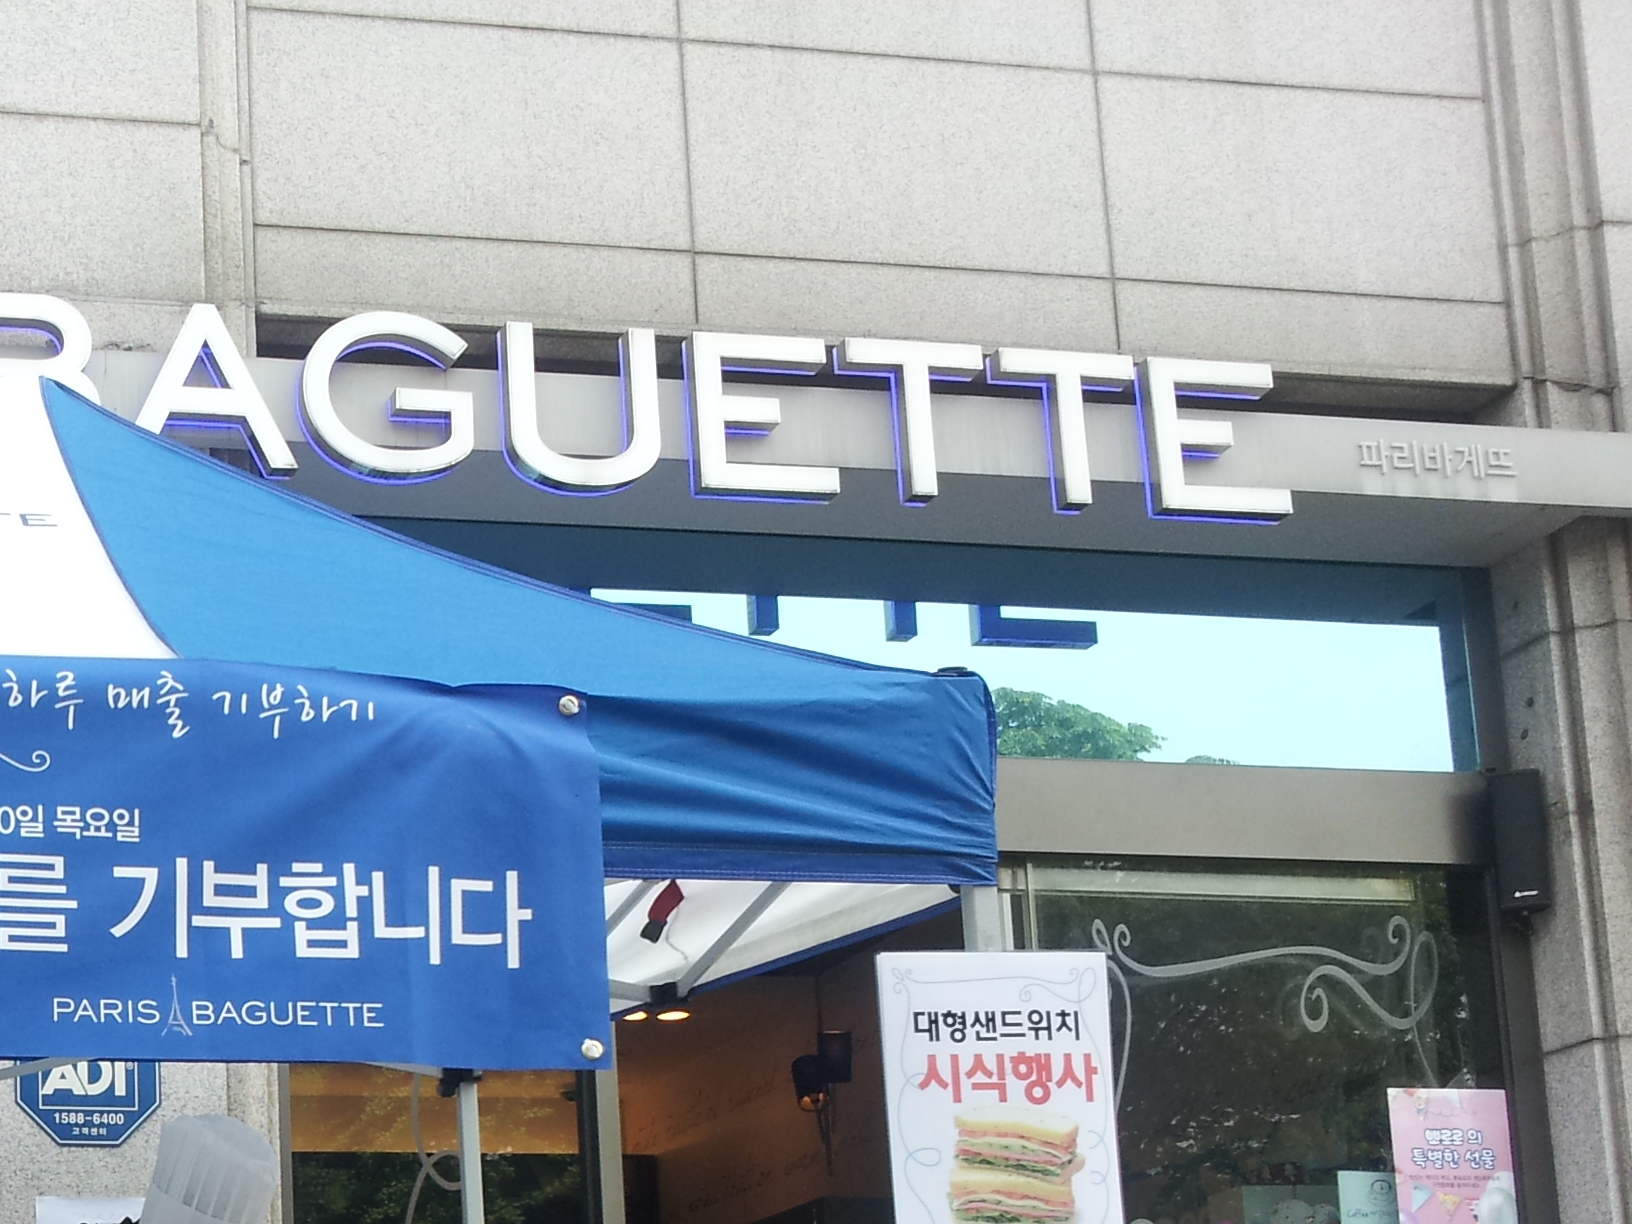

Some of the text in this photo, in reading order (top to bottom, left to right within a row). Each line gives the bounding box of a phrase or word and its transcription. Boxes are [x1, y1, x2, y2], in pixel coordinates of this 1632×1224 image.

[1358, 438, 1517, 480] 파리바게뜨
[1, 668, 84, 732] 하루
[106, 669, 191, 740] 매출
[211, 682, 377, 739] 기부하기
[53, 806, 142, 843] 목요일
[109, 856, 534, 970] 기부합니다
[52, 995, 386, 1029] PARIS BAGUETTE
[913, 1009, 1081, 1044] 대형샌드위치
[917, 1050, 1099, 1106] 시식행사
[53, 1111, 125, 1126] 1588-6400
[71, 1126, 107, 1137] 고객센터
[1467, 1128, 1484, 1147] 의
[1411, 1147, 1497, 1171] 특별한 선물
